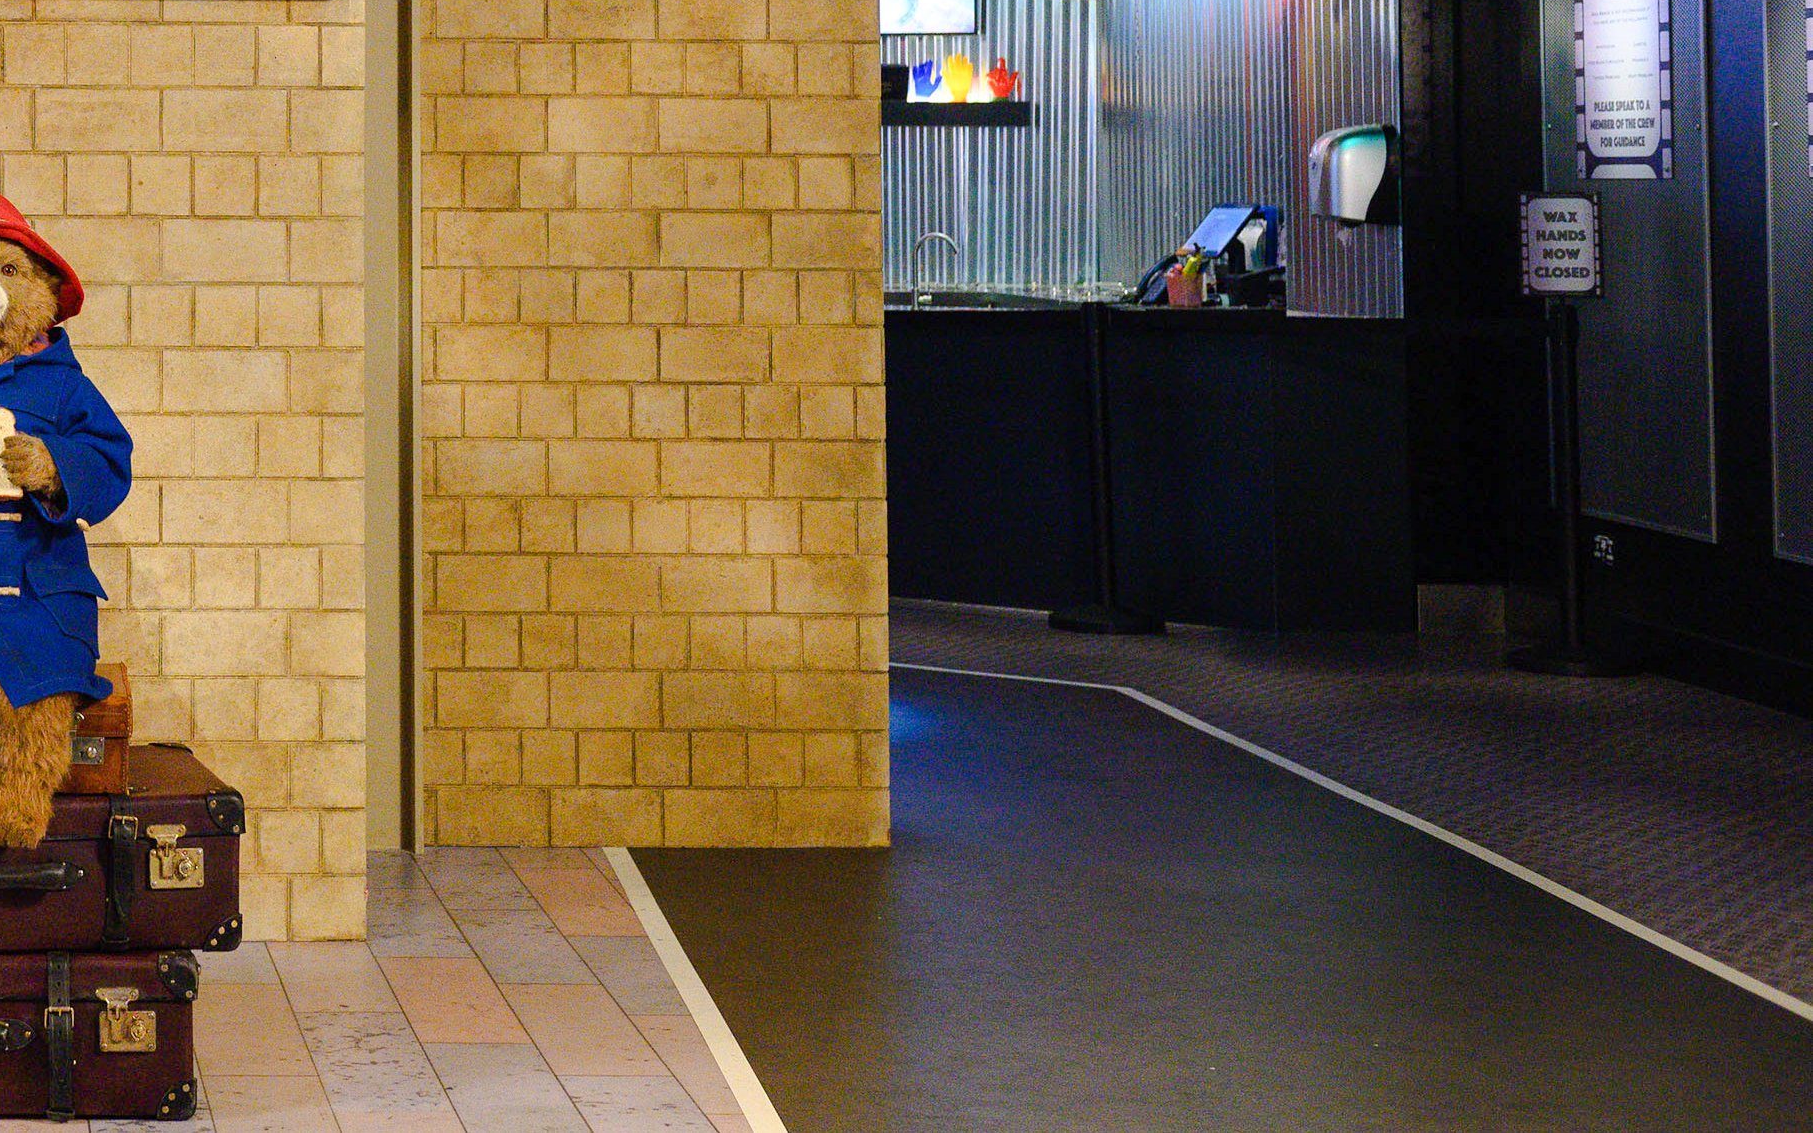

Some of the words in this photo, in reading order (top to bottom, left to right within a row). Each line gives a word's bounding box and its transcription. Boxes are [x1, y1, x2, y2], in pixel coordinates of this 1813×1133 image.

[1594, 101, 1615, 112] PLEASE
[1616, 100, 1635, 112] SPEAK
[1636, 100, 1644, 110] TO
[1590, 120, 1615, 130] MEMBER
[1616, 119, 1624, 129] OF
[1625, 118, 1636, 129] THE
[1637, 118, 1655, 128] CREW
[1600, 137, 1613, 147] FOR
[1614, 136, 1646, 147] GUIDANCE
[1543, 211, 1578, 222] WAX
[1536, 230, 1586, 241] HANDS
[1542, 248, 1580, 259] NOW
[1534, 266, 1590, 278] CLOSED
